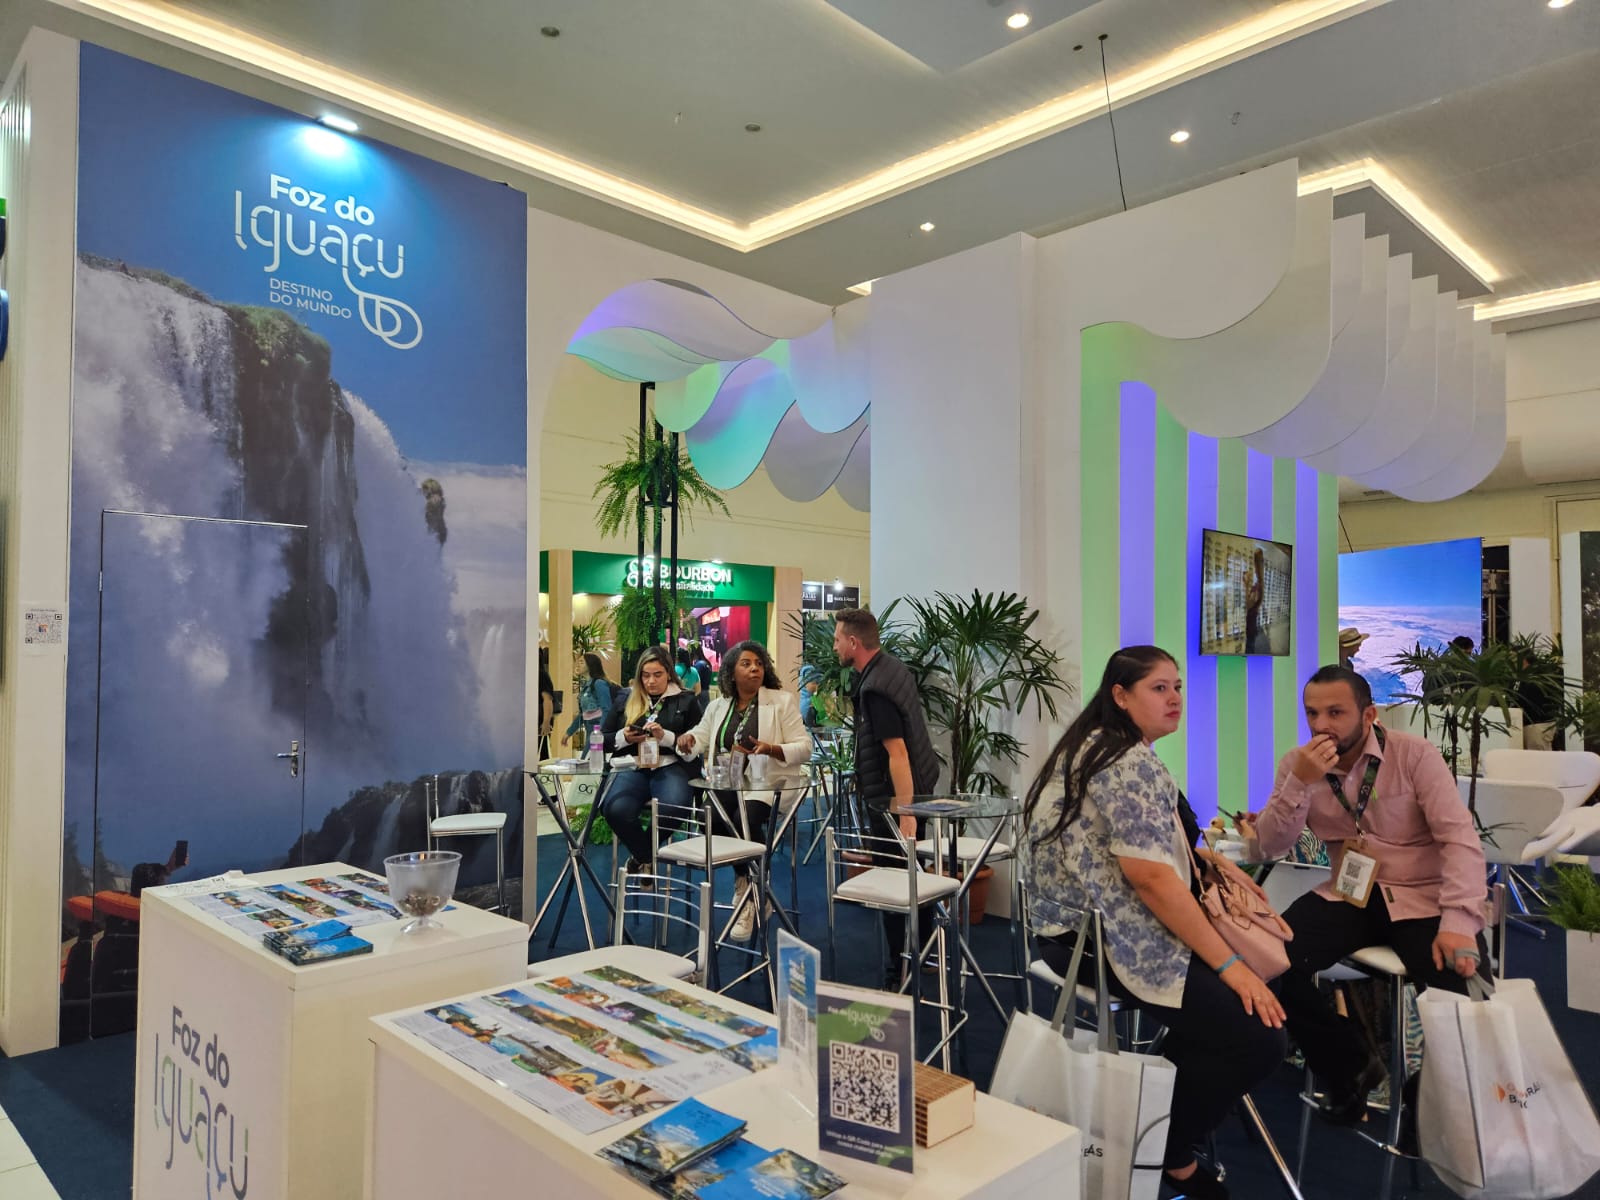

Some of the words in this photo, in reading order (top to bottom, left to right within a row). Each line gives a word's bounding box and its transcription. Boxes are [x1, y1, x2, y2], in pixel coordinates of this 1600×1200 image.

[270, 173, 327, 214] Foz
[334, 195, 375, 226] do
[235, 189, 405, 282] Iguaçu
[269, 277, 333, 302] DESTINO
[269, 291, 293, 306] DO
[296, 298, 352, 319] MUNDO
[171, 1004, 201, 1067] Foz
[205, 1032, 230, 1089] do
[154, 1032, 249, 1200] Iguaçu
